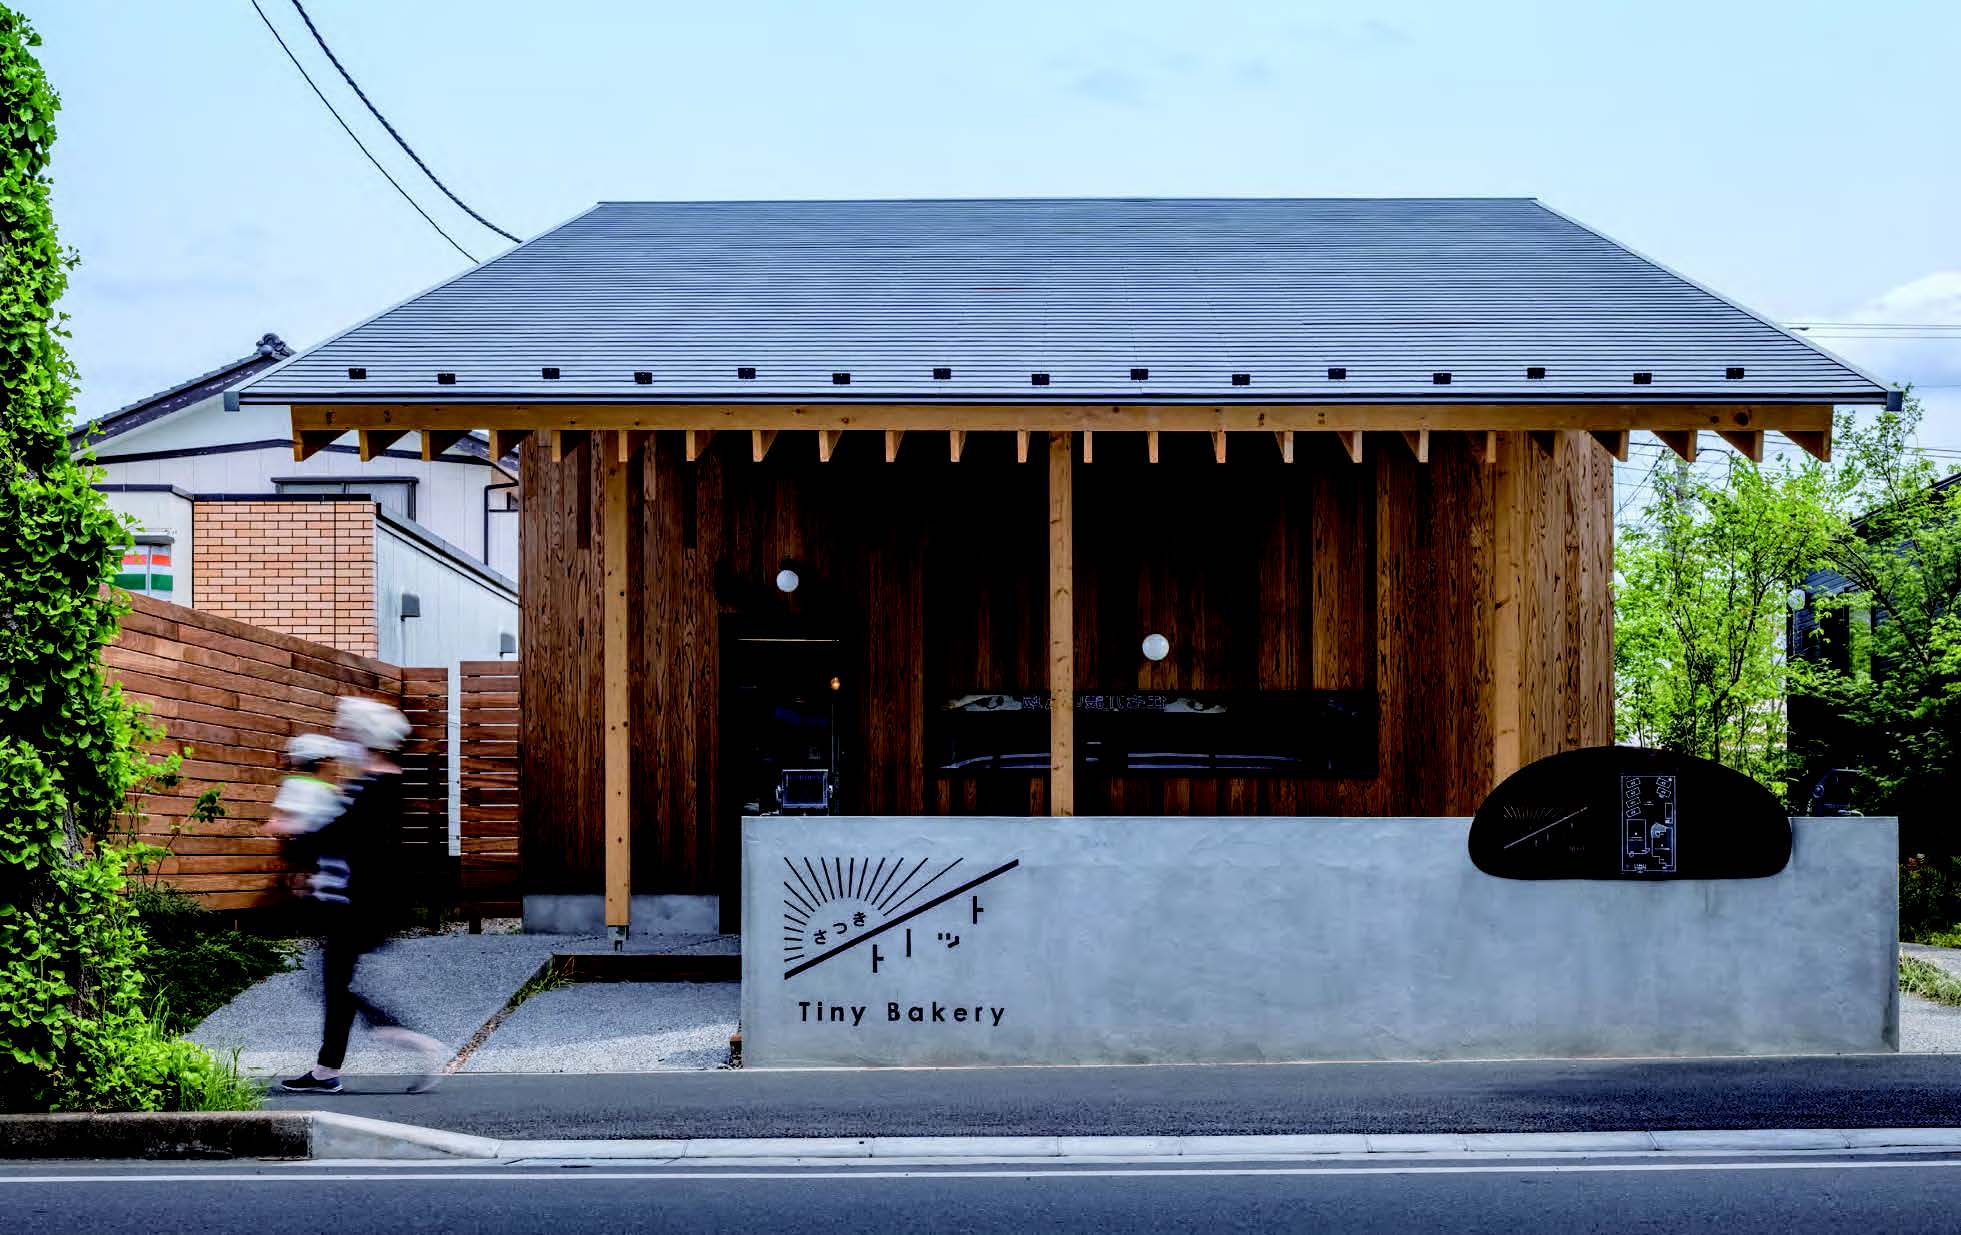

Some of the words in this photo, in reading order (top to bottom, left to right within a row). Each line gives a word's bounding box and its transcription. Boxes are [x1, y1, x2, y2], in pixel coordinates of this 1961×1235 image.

[813, 911, 867, 945] さつき
[798, 1001, 866, 1027] Tiny
[887, 1002, 1005, 1027] Bakery
